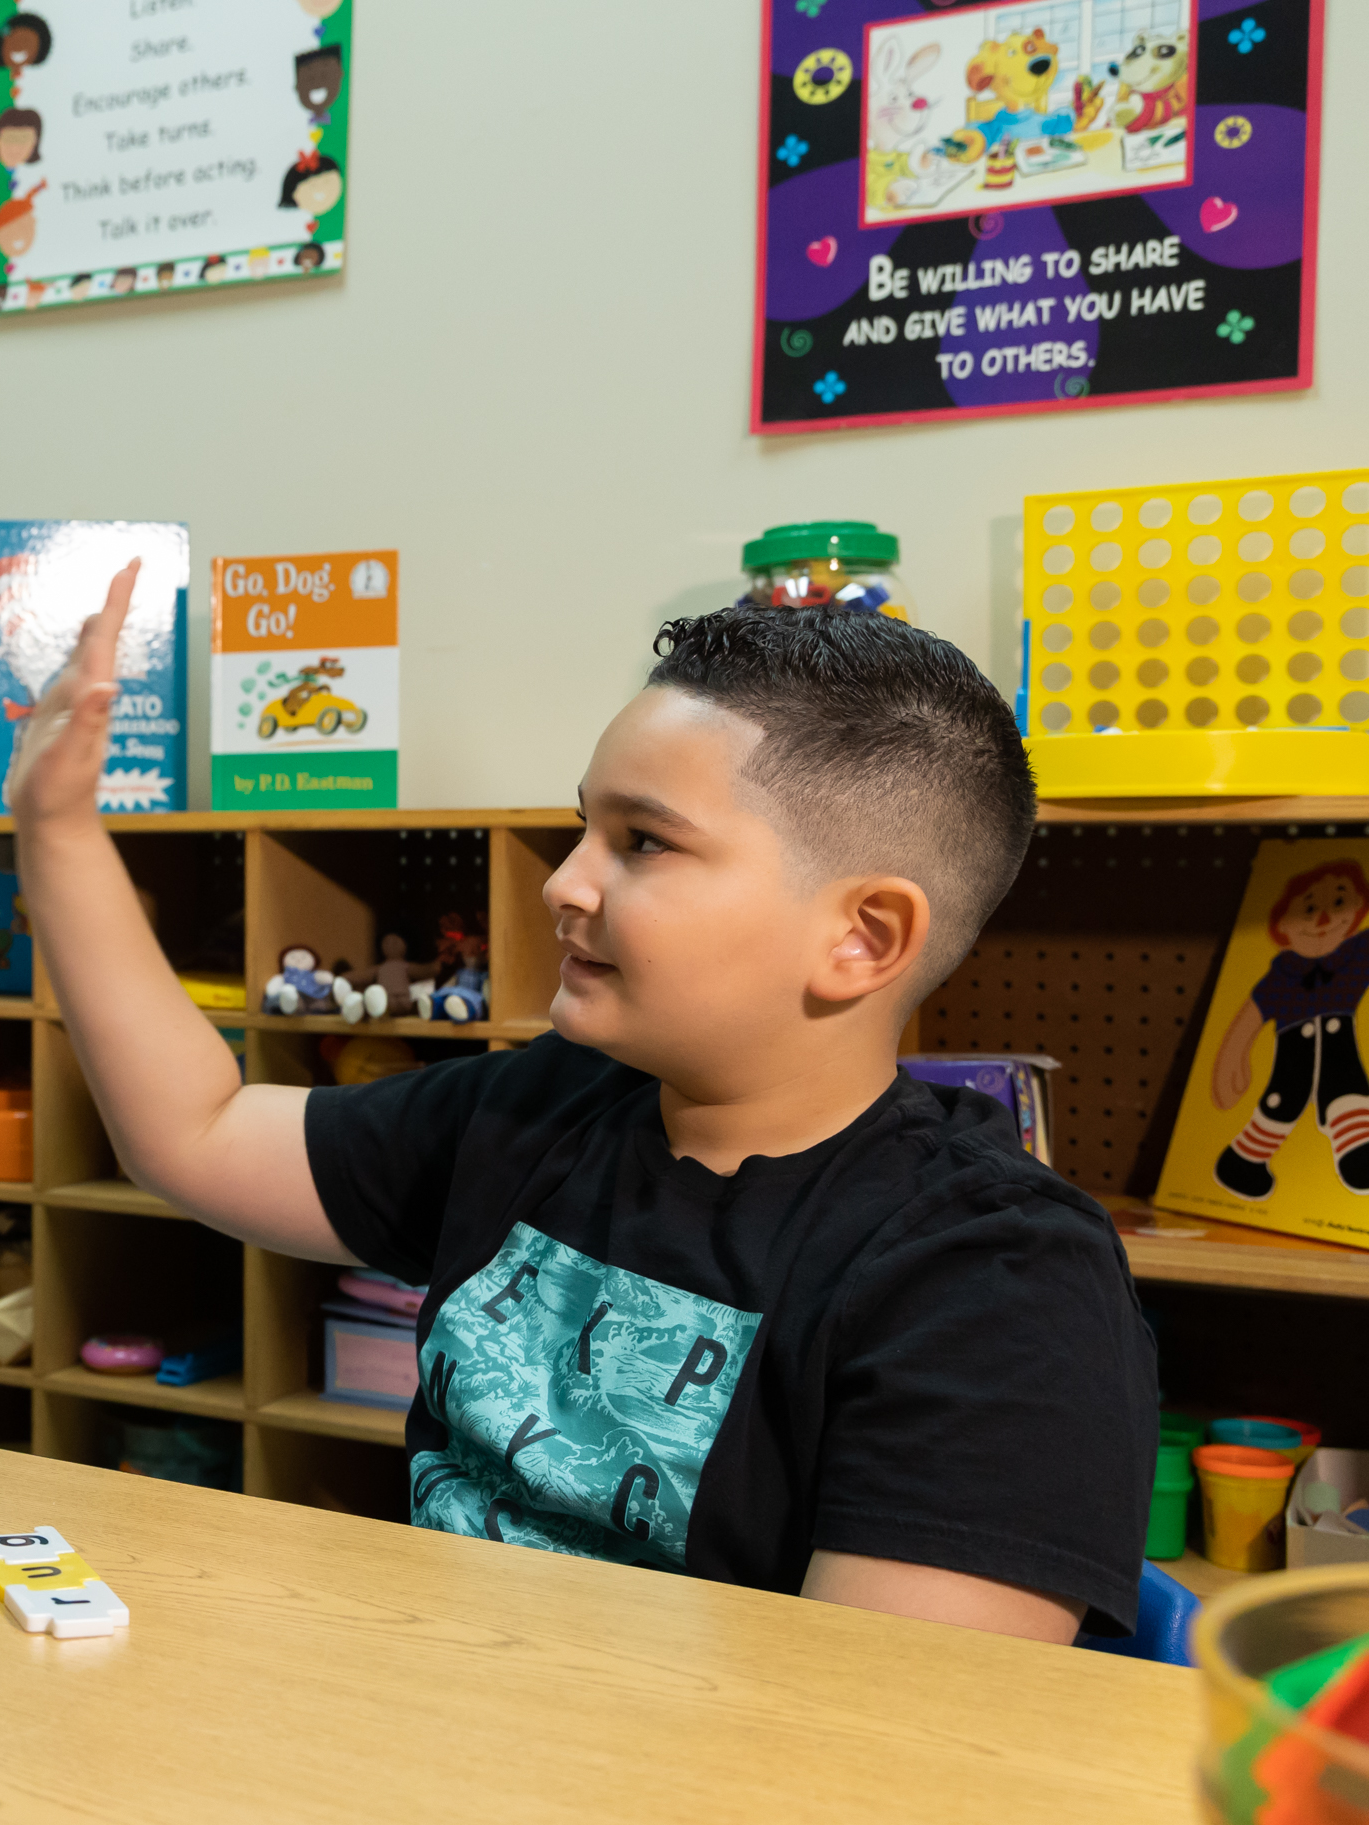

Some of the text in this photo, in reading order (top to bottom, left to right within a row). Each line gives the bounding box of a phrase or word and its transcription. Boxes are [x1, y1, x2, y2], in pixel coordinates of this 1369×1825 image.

[130, 35, 194, 62] Share.
[71, 67, 250, 118] Encourage others.
[104, 118, 215, 152] Take turns.
[60, 158, 259, 202] Think before acting.
[99, 210, 217, 241] Talk it over.
[917, 253, 1034, 295] WILLING
[1042, 248, 1081, 279] TO
[1089, 236, 1181, 276] SHARE
[842, 280, 1205, 347] AND GIVE WHAT YOU HAVE
[936, 341, 1096, 381] TO OTHERS.
[274, 561, 336, 603] Dog.
[246, 602, 297, 639] Go!
[234, 774, 255, 795] by
[296, 772, 373, 791] Eastman
[663, 1334, 728, 1407] P
